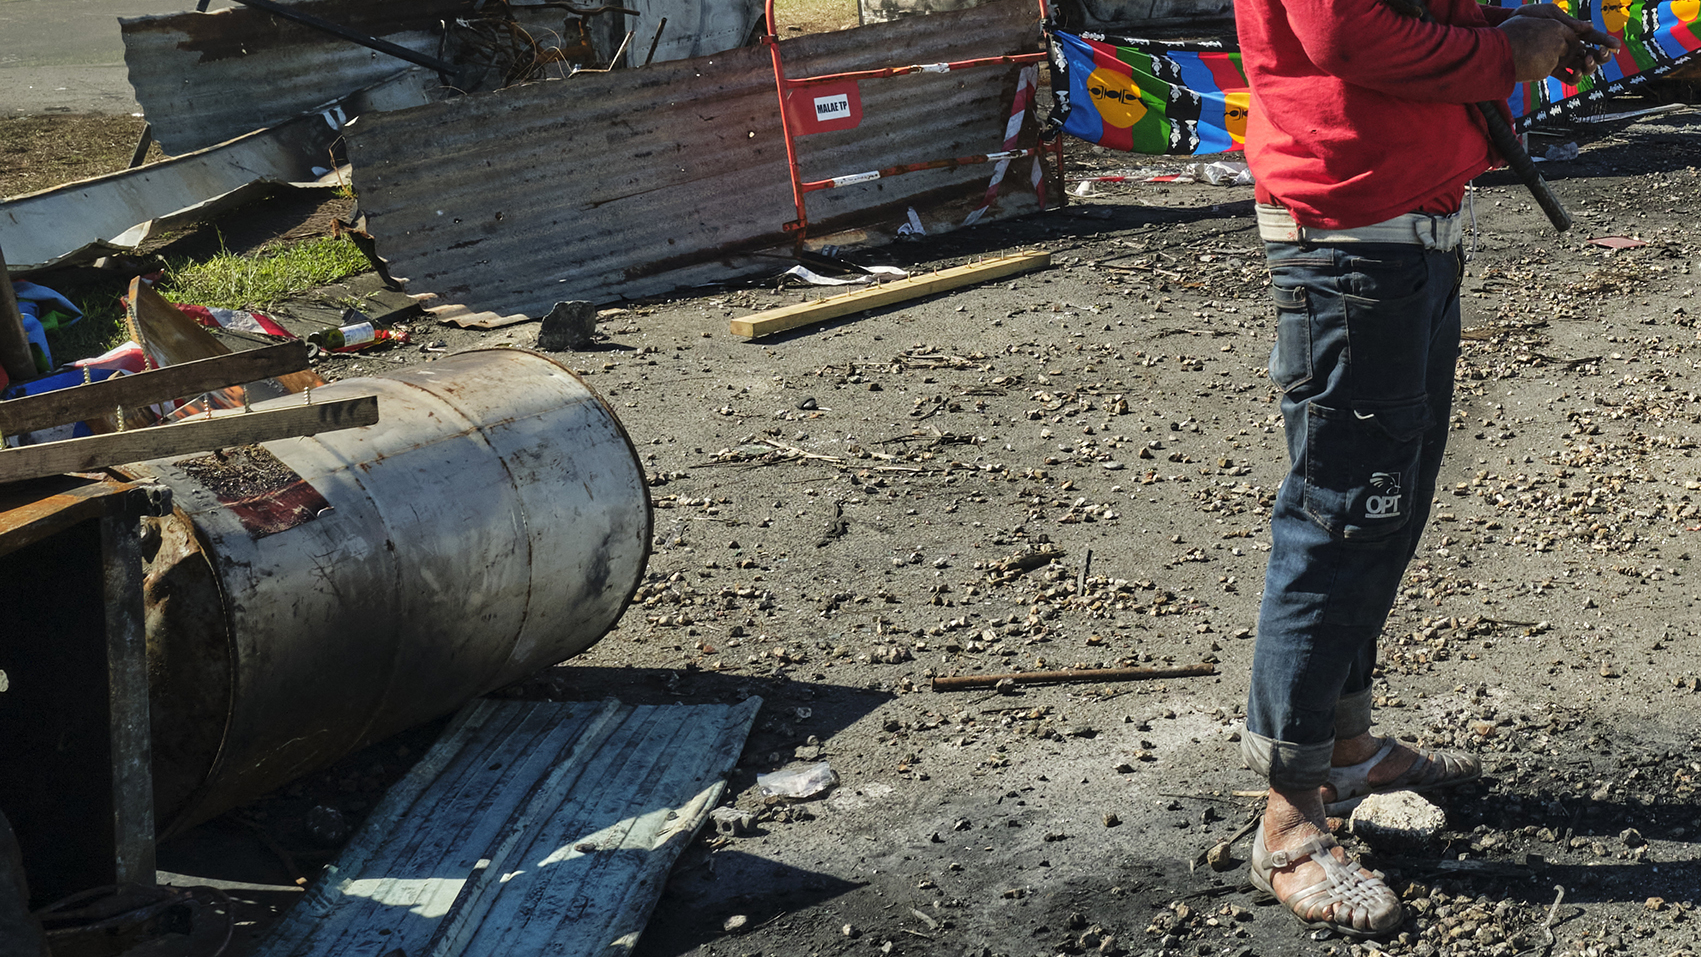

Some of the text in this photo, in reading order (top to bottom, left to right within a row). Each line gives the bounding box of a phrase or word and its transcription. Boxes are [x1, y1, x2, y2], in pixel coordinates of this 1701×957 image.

[816, 101, 847, 114] MALAE TP
[1365, 494, 1402, 514] OPT
